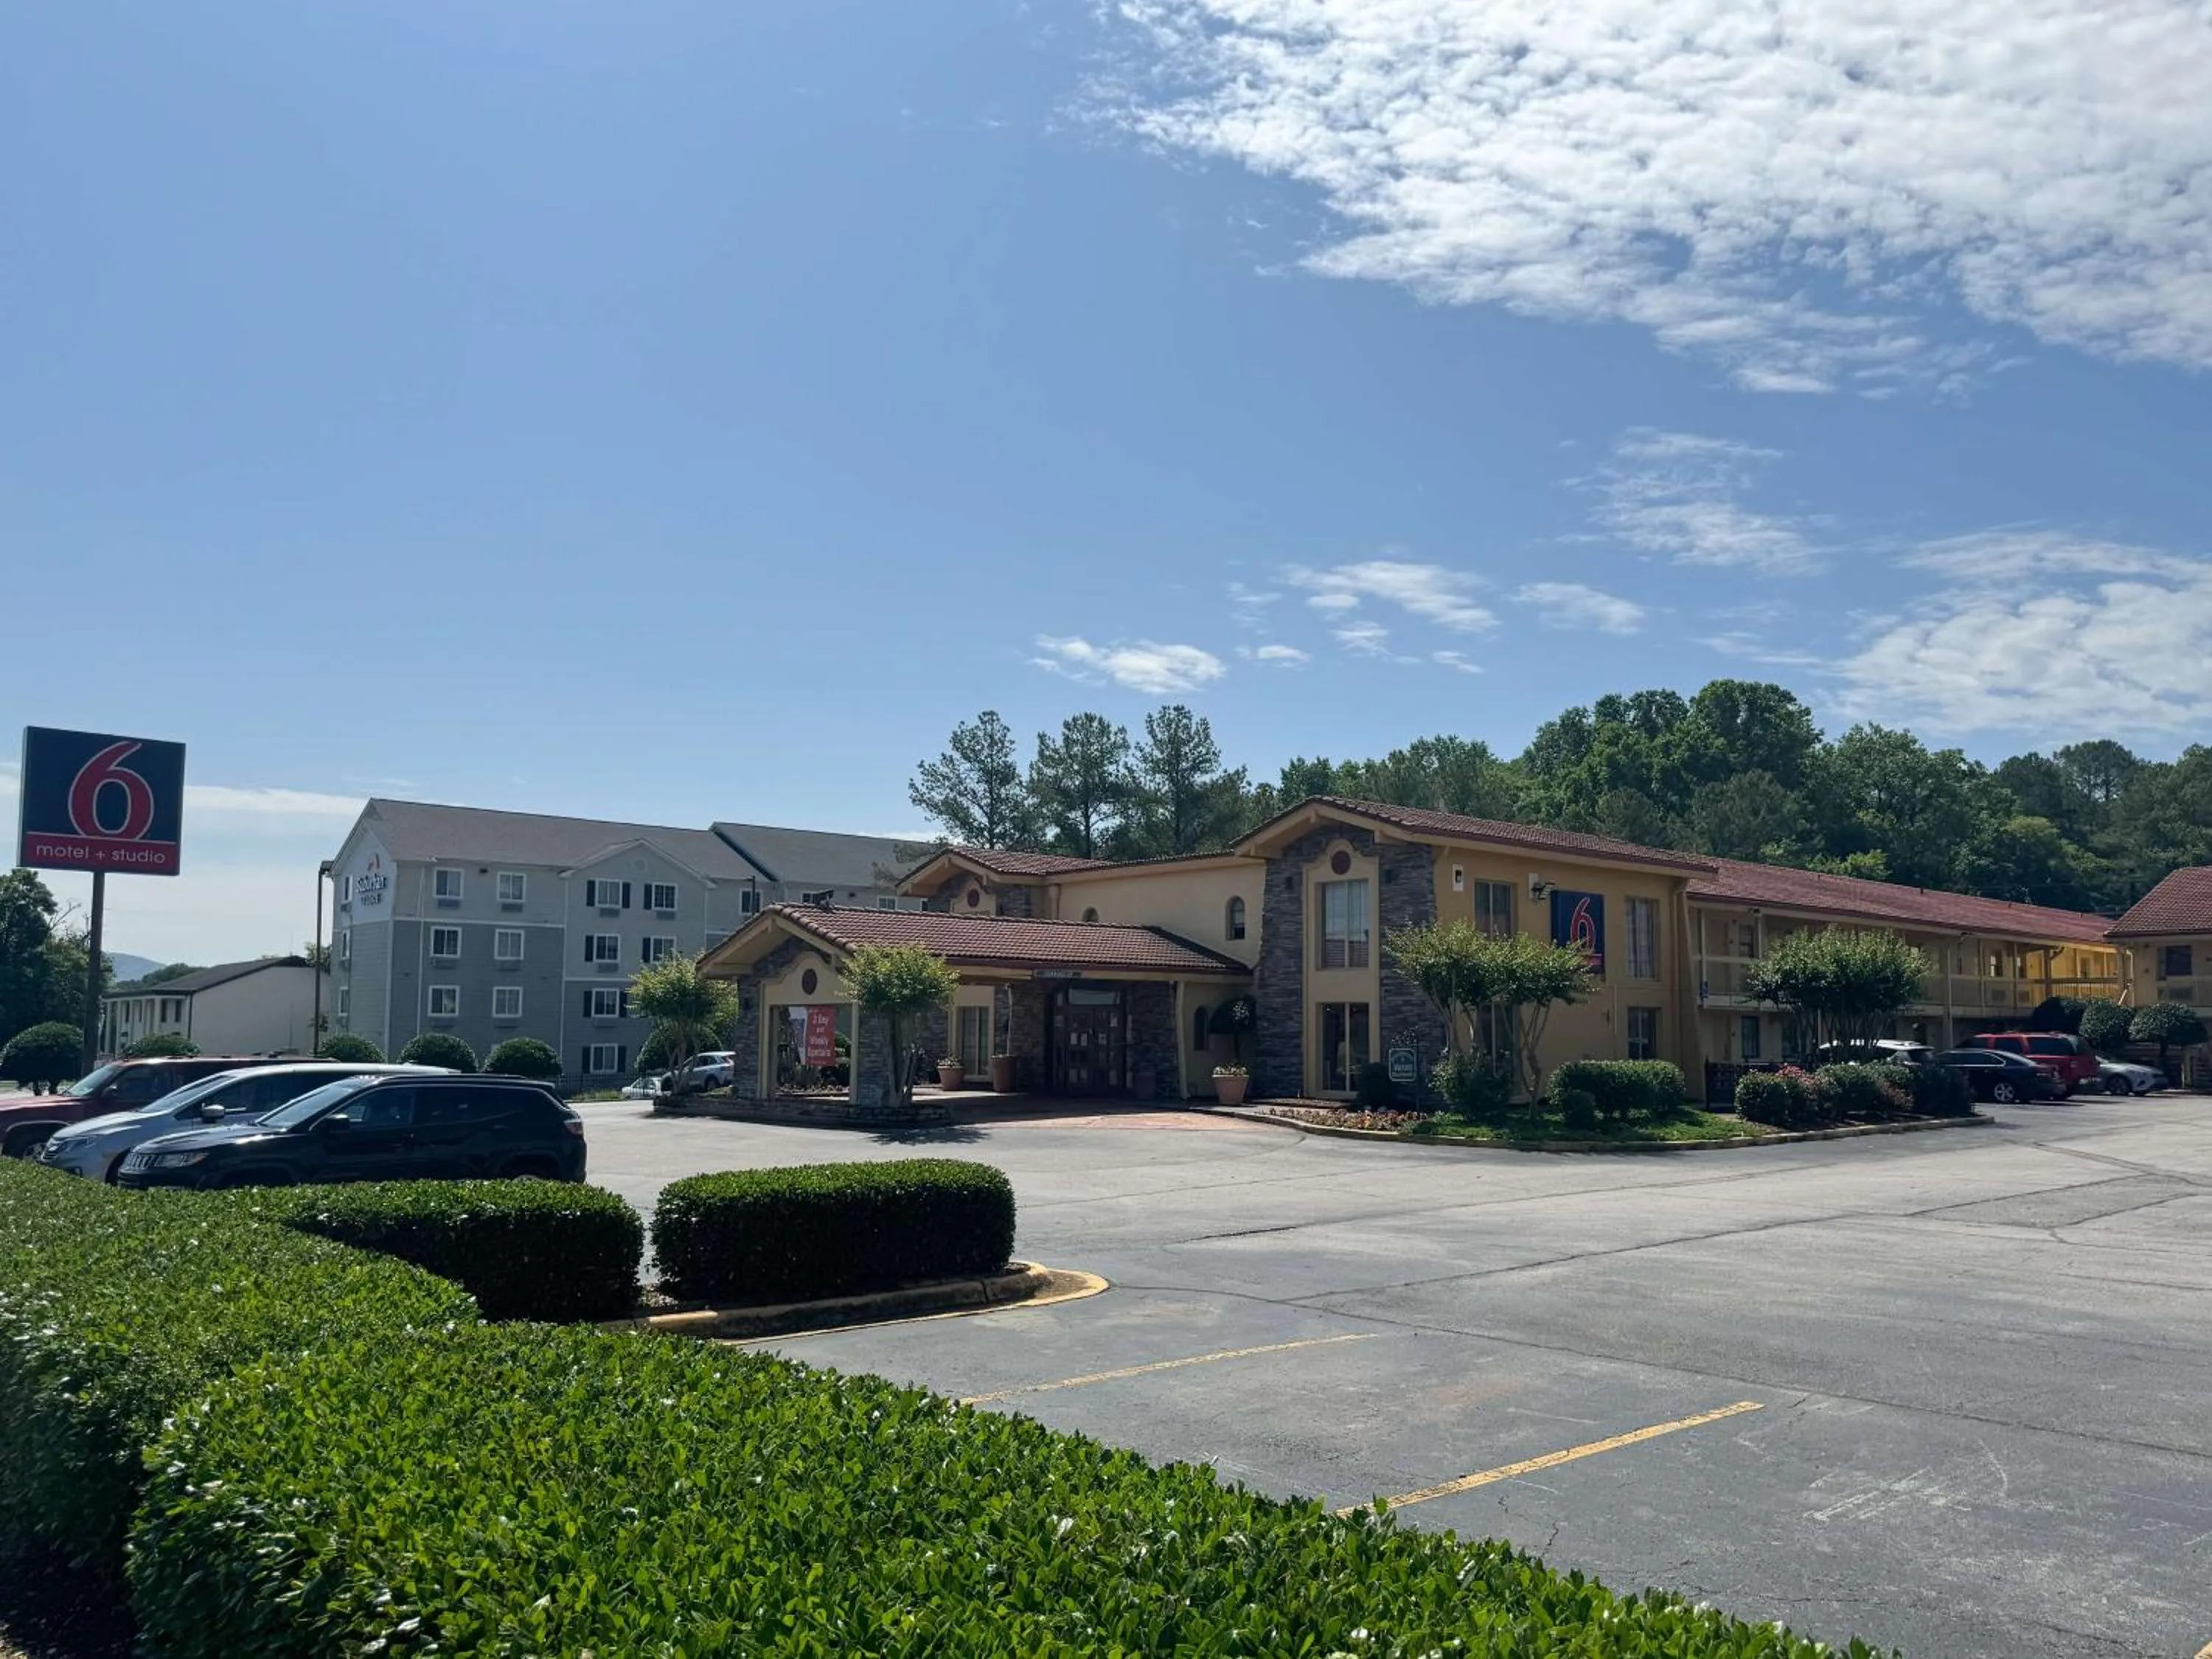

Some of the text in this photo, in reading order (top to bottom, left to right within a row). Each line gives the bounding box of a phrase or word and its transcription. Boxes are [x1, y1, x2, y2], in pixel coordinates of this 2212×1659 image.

[68, 740, 154, 841] 6
[36, 844, 89, 860] motel
[111, 849, 166, 864] studio
[1570, 897, 1596, 953] 6
